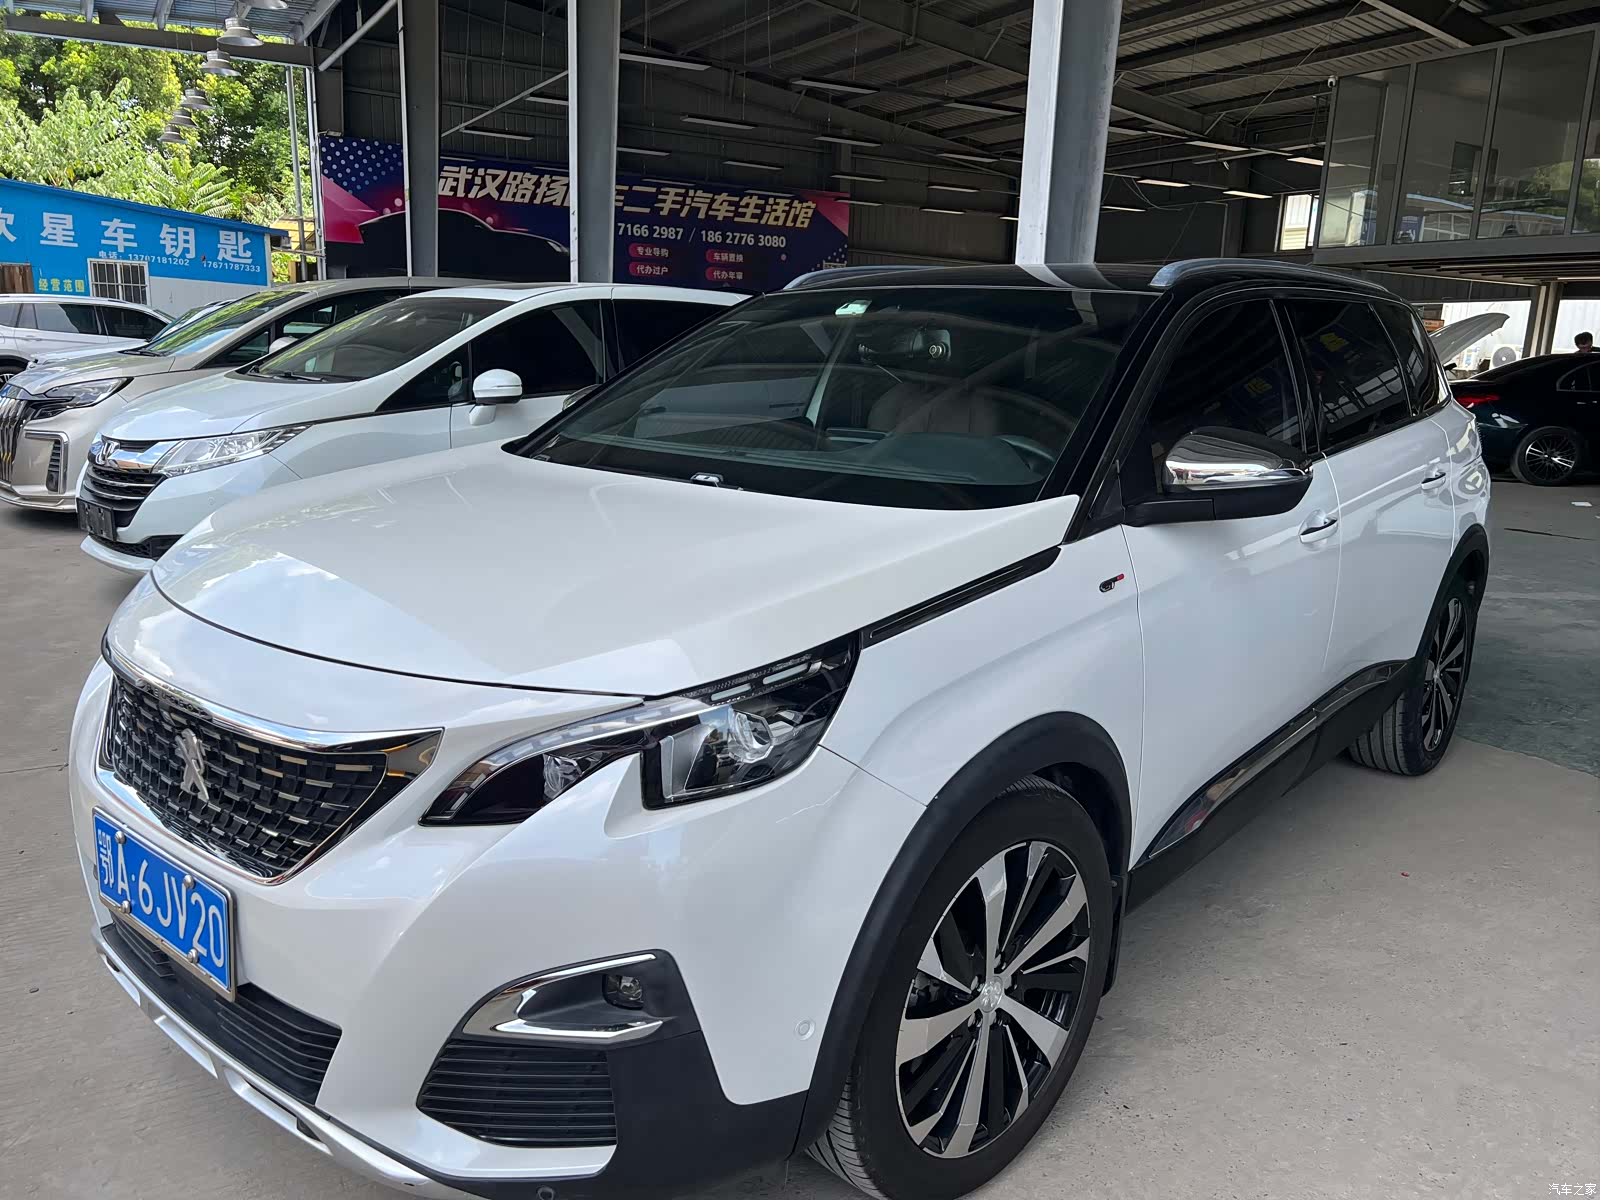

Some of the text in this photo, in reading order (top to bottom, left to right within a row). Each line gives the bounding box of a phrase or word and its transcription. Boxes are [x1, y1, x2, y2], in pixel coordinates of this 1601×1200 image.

[438, 165, 816, 228] 武汉路扬二手汽车生活馆
[617, 222, 649, 238] 7166
[653, 225, 684, 240] 2987
[701, 230, 722, 243] 186
[726, 231, 755, 246] 2776
[758, 234, 786, 248] 3080
[636, 245, 669, 258] 专业导购
[713, 252, 744, 263] 车辆置换
[202, 260, 261, 273] 17671787333
[636, 264, 668, 275] 代办过户
[38, 278, 85, 293] 经营范围
